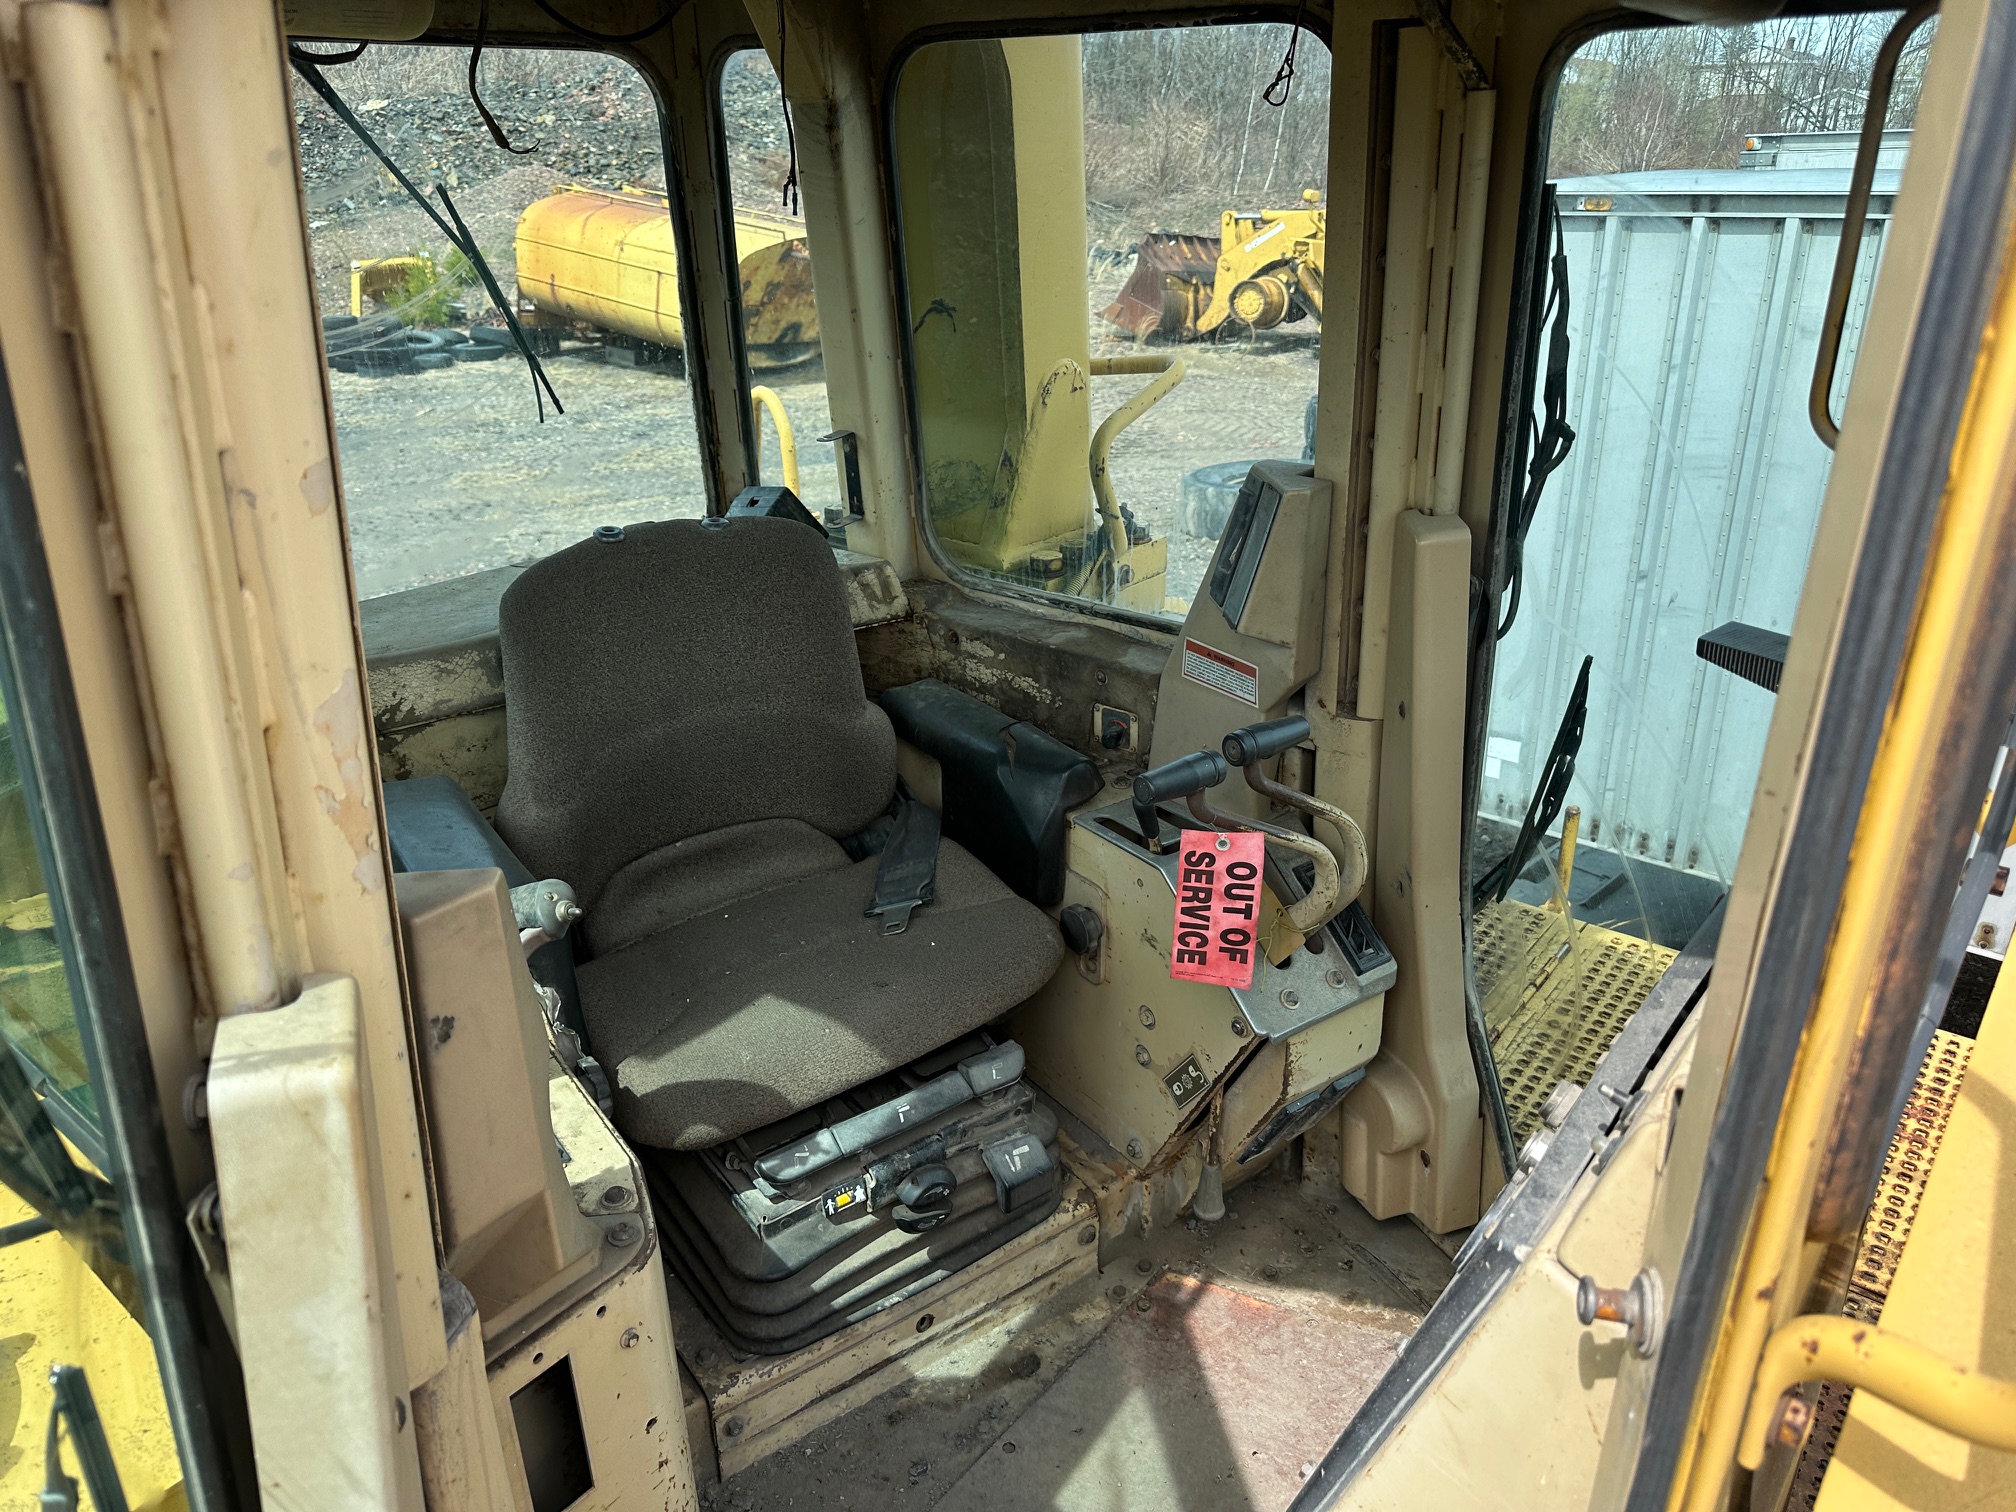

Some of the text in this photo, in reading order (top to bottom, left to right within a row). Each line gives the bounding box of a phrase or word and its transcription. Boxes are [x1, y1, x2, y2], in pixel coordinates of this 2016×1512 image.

[1213, 654, 1235, 667] WARNING
[1176, 850, 1217, 966] SERVICE
[1222, 861, 1258, 921] OUT
[1218, 928, 1251, 965] OF
